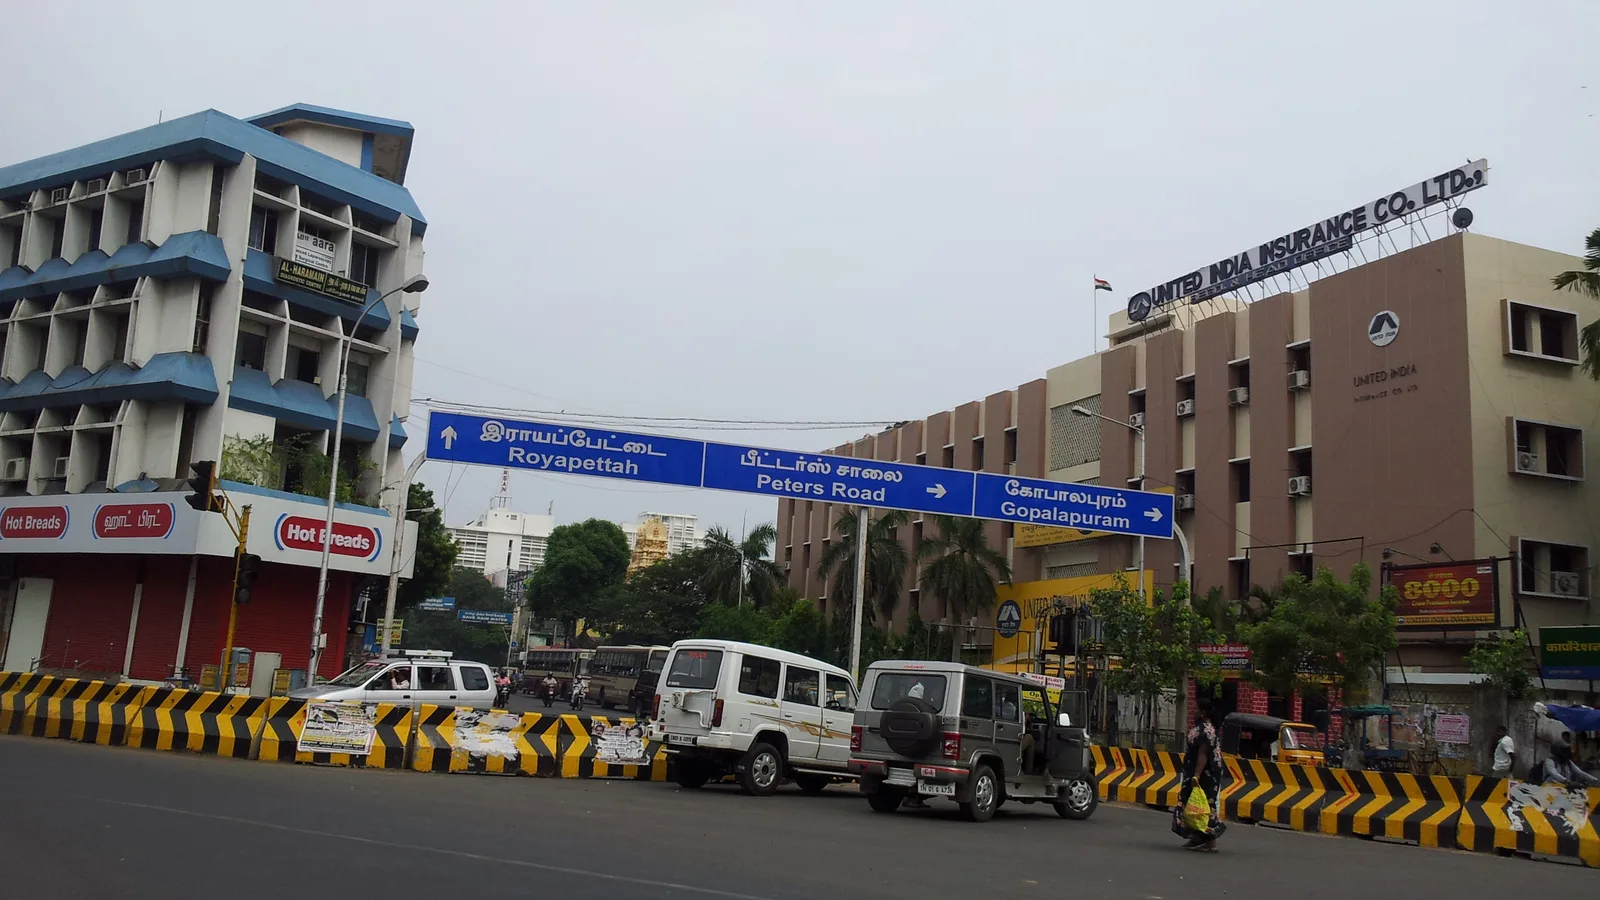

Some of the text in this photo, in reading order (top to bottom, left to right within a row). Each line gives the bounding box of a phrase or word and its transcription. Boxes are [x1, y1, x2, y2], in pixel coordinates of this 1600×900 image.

[312, 236, 334, 252] aara
[1151, 270, 1204, 306] UNITED
[1209, 253, 1252, 285] INDIA
[1258, 206, 1367, 266] INSURANCE
[1374, 191, 1416, 222] CO.
[1245, 258, 1289, 281] HEAD
[1293, 237, 1349, 264] OFFICE
[1353, 364, 1417, 388] UNITED INDIA
[479, 420, 667, 457] இராயப்பேட்டை
[508, 446, 639, 476] Royapettah
[740, 450, 903, 483] பீட்டர்ஸ் சாலை
[756, 473, 886, 502] Peters Road
[1004, 479, 1128, 510] கோபாலபுரம்
[5, 514, 61, 530] Hot Breads
[104, 509, 132, 533] ஹாட்
[1000, 501, 1131, 529] Gopalapuram
[287, 523, 371, 551] Hot Breads
[1403, 577, 1480, 600] 8000
